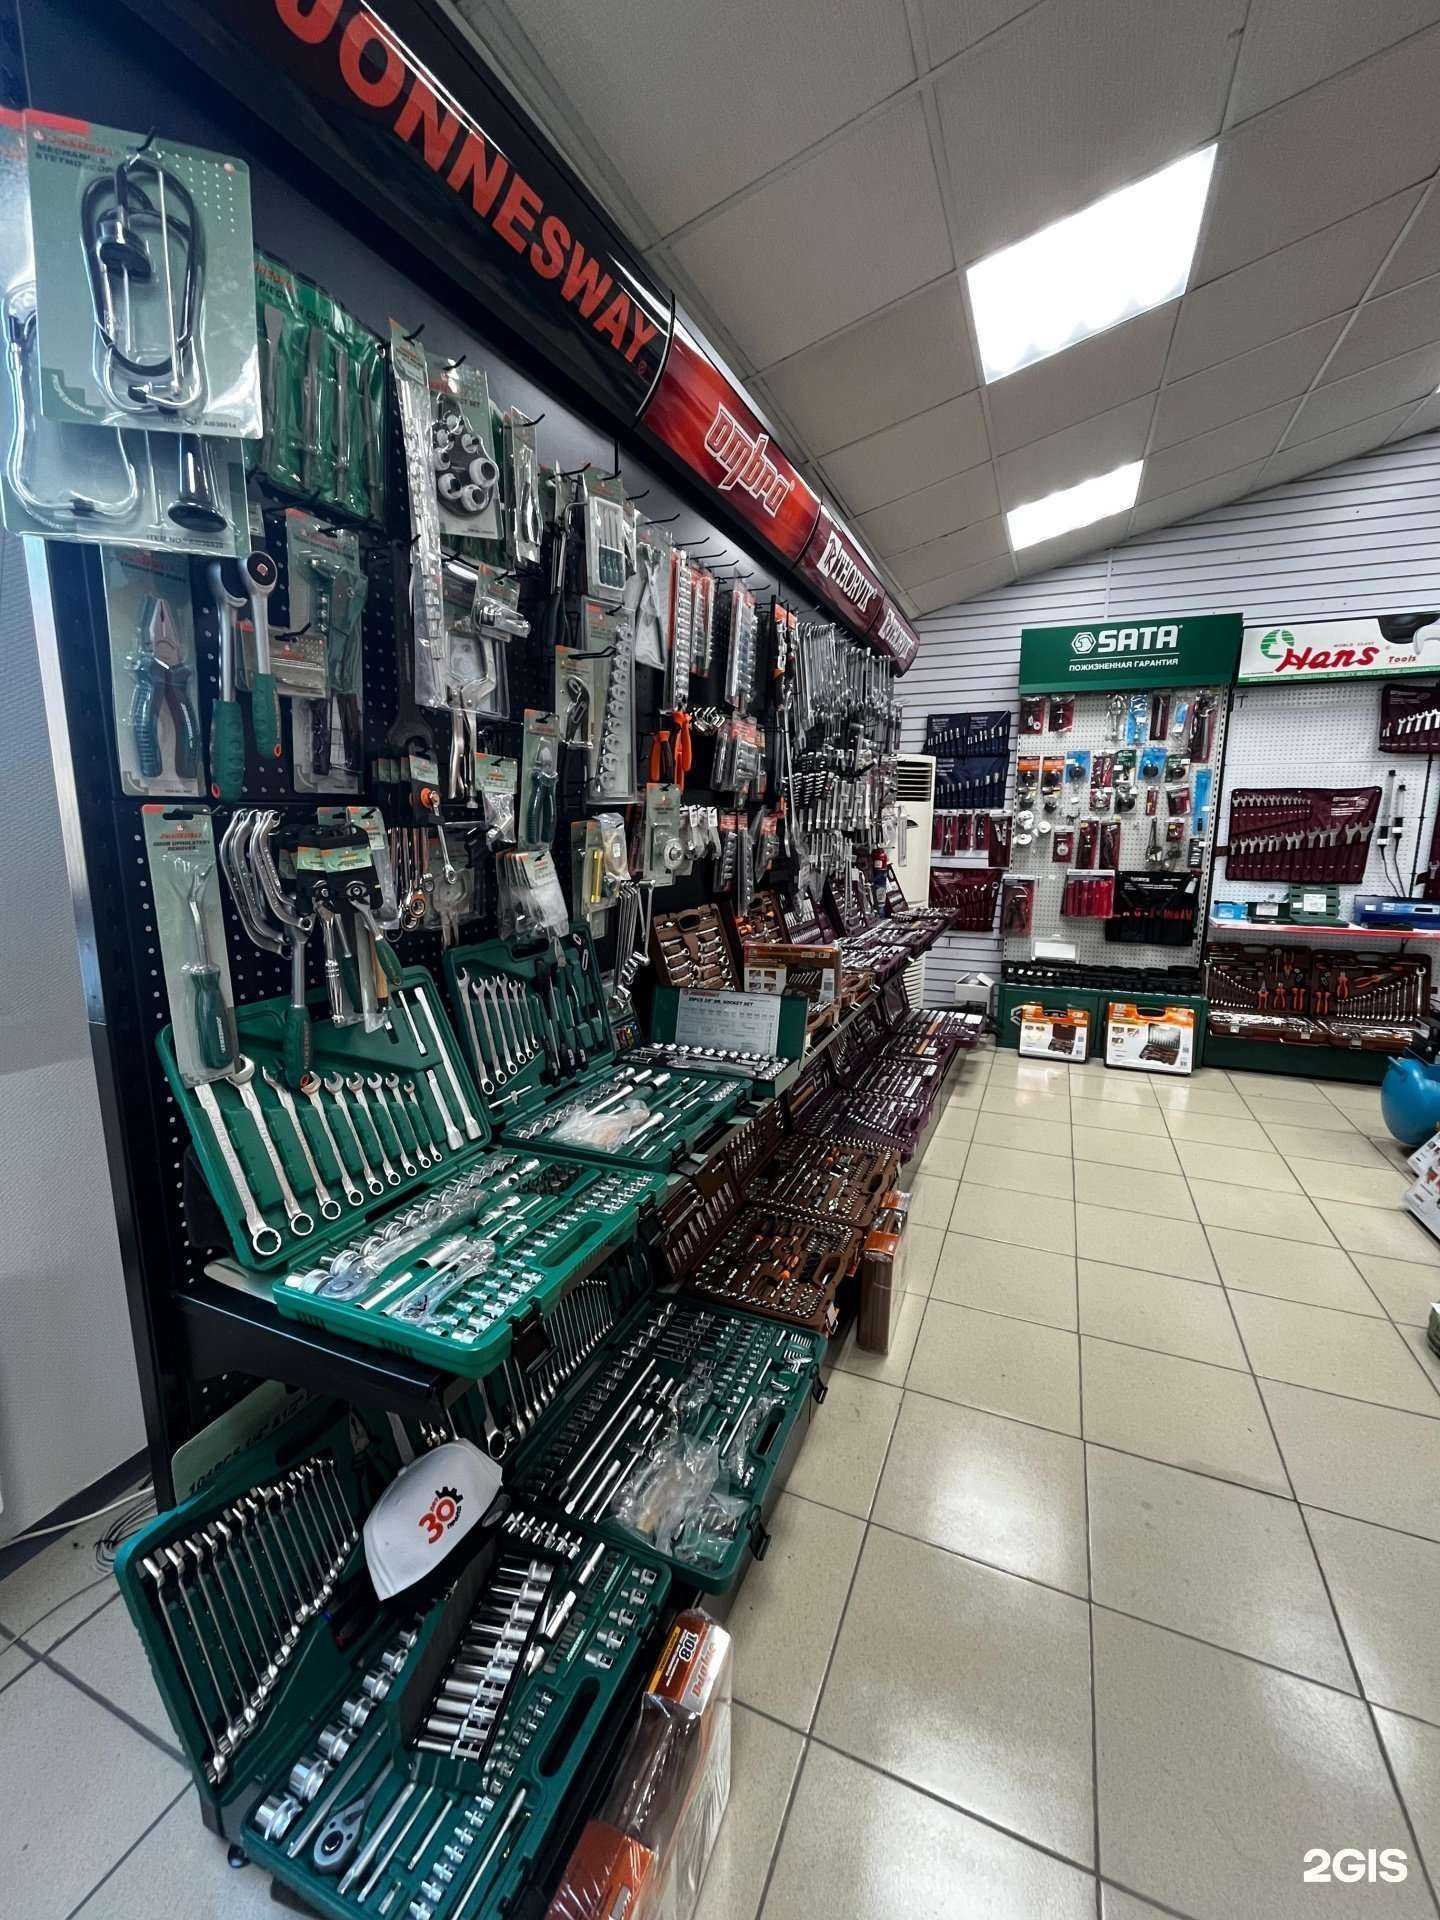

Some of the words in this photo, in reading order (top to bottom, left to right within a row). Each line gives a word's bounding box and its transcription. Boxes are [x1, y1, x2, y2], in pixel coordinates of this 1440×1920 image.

[831, 544, 877, 613] THORVIK
[1098, 625, 1179, 653] SATA
[1069, 661, 1132, 672] ПОЖИЗНЕННАЯ
[1134, 658, 1179, 668] ГАРАНТИЯ
[1275, 646, 1380, 673] Hans
[1388, 655, 1416, 664] Tools
